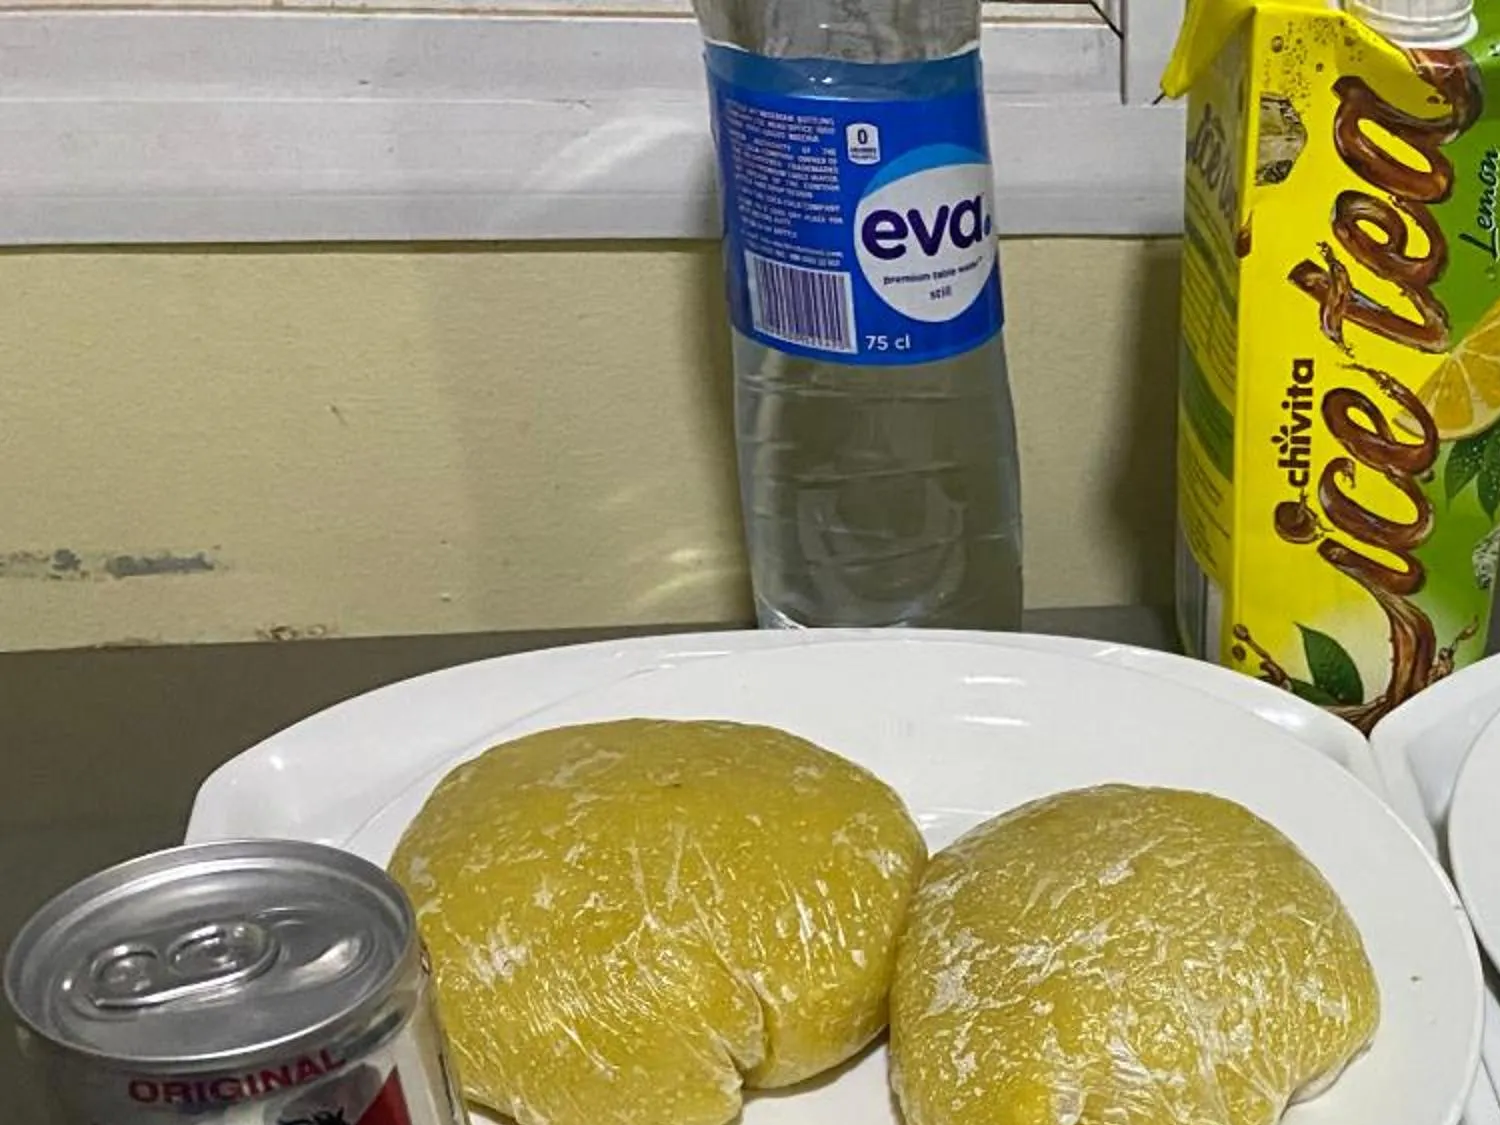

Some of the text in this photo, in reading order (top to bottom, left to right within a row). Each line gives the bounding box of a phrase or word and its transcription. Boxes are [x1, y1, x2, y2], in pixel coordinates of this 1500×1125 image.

[857, 128, 868, 145] 0
[1286, 50, 1483, 356] tea
[1458, 143, 1500, 264] Lemon
[865, 335, 889, 351] 75
[894, 334, 911, 350] cl
[1271, 358, 1315, 488] chivita
[1274, 364, 1440, 598] ice
[127, 1047, 347, 1105] ORIGINAL
